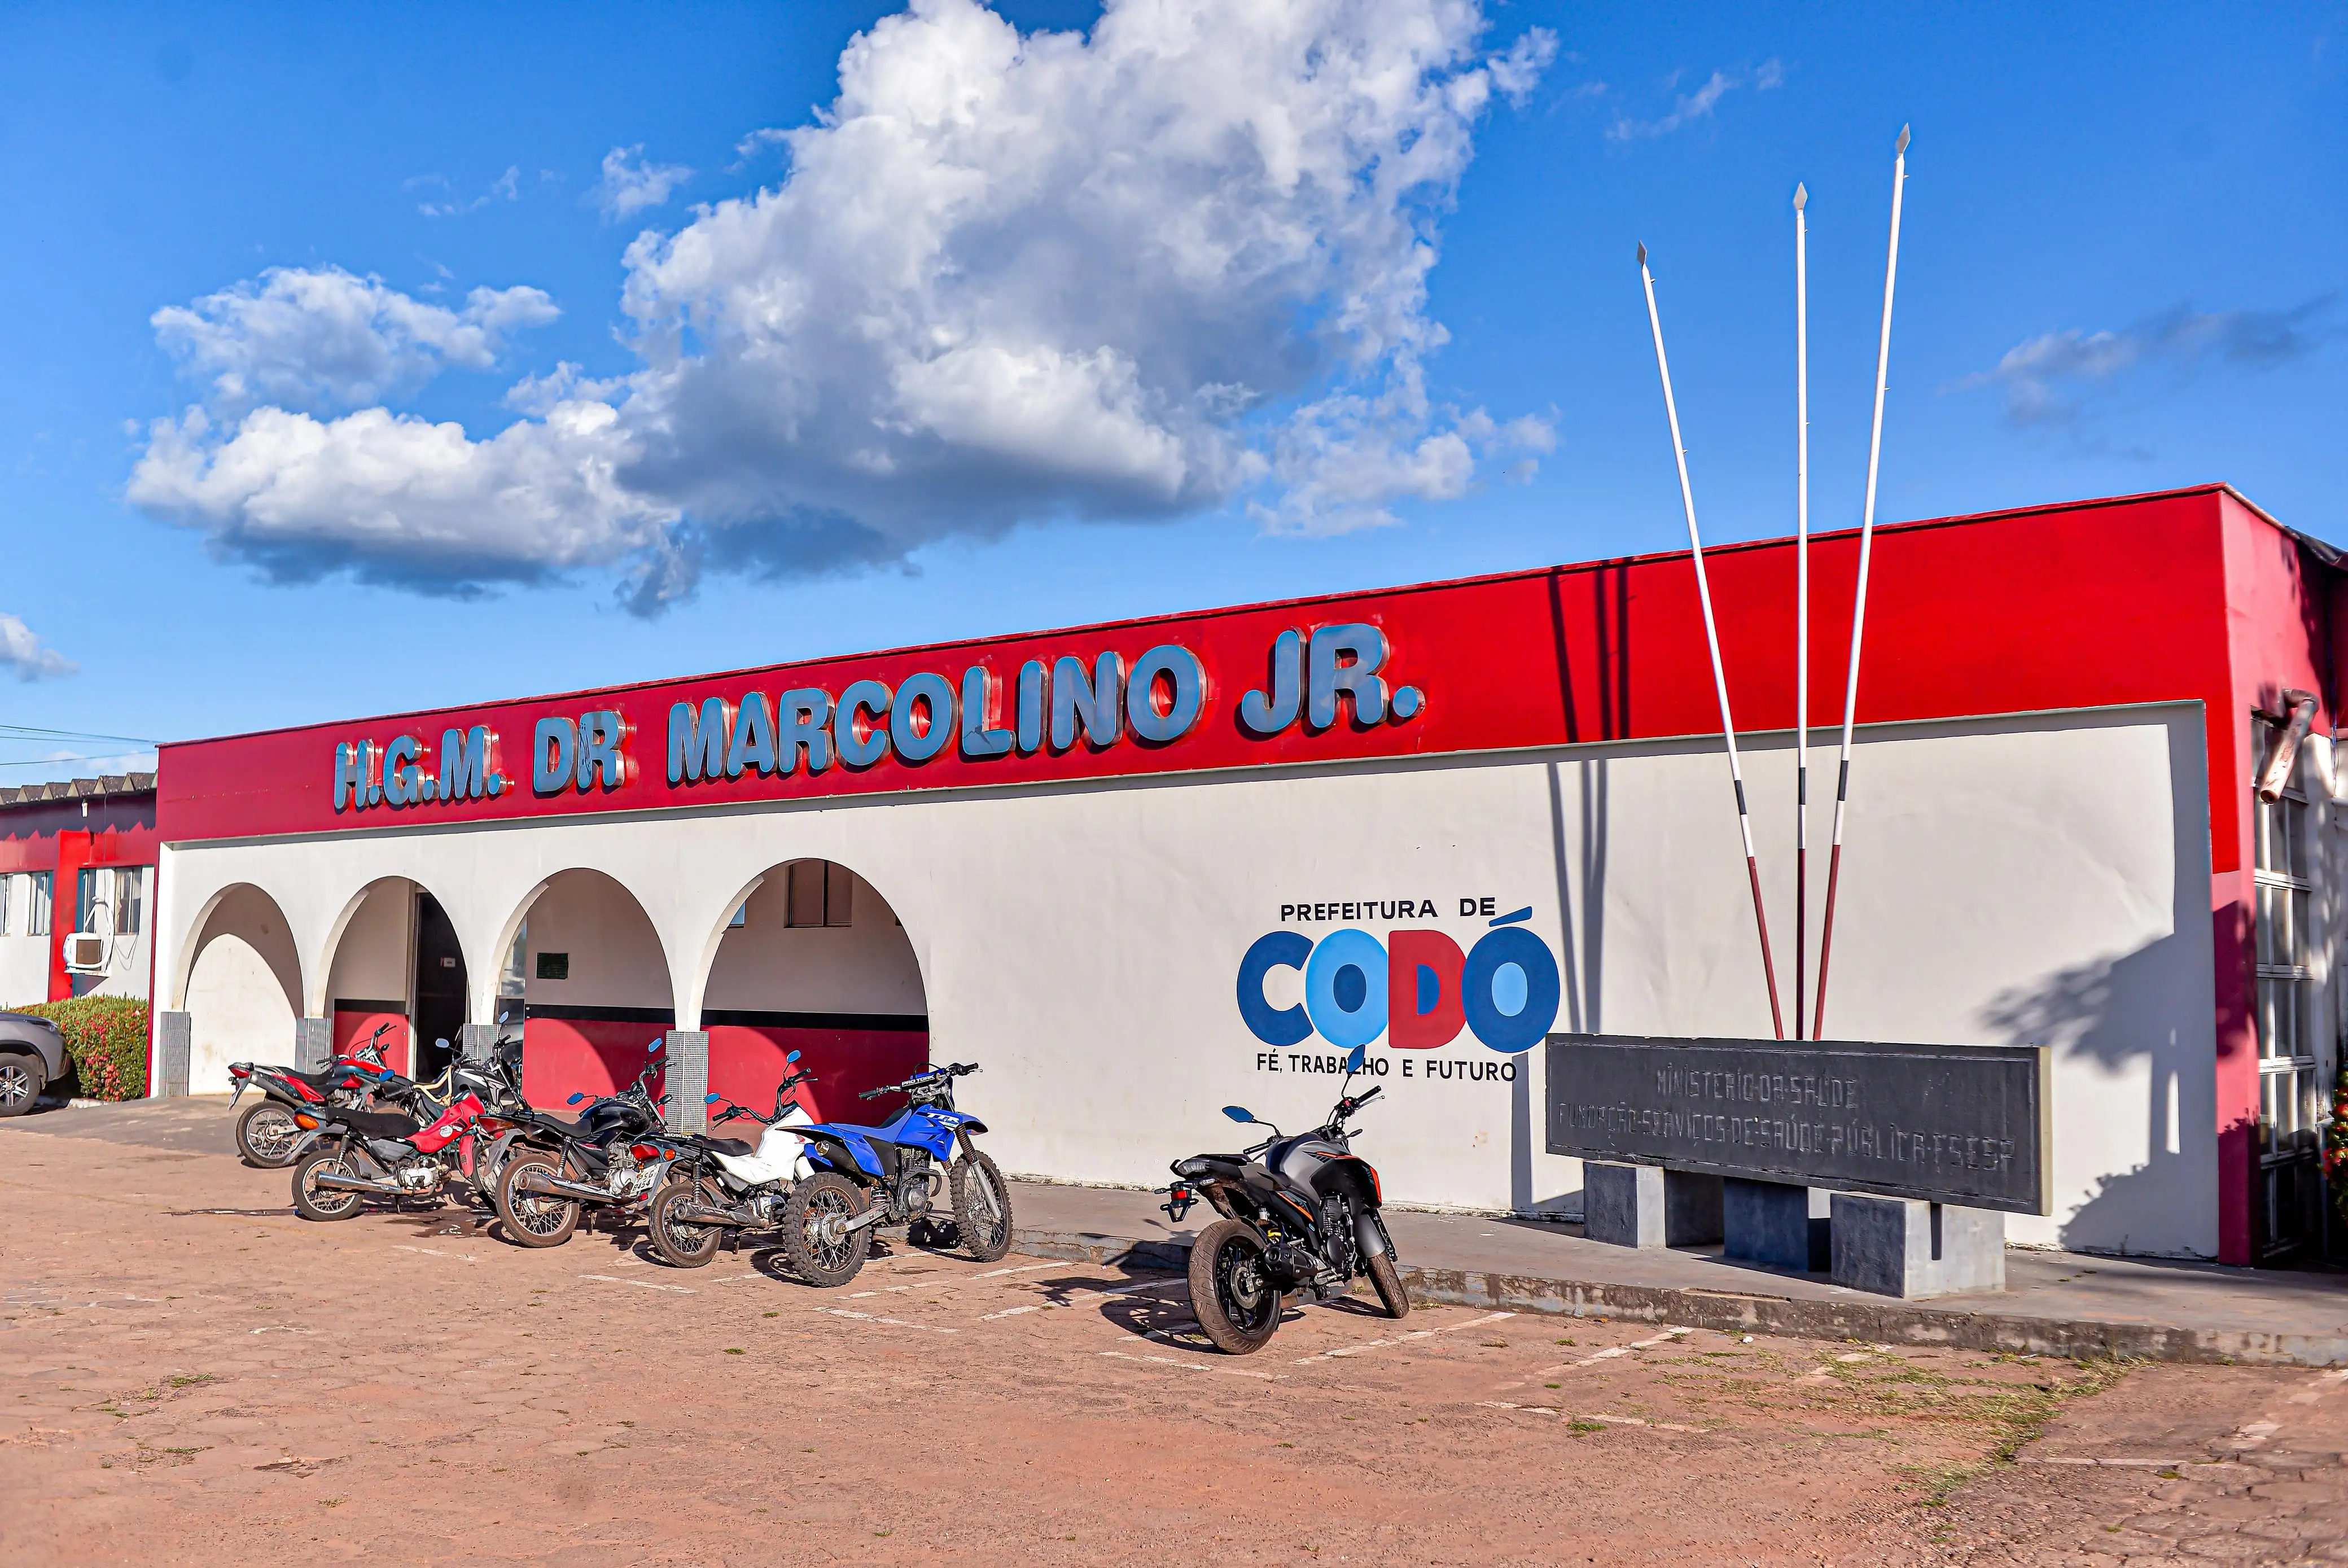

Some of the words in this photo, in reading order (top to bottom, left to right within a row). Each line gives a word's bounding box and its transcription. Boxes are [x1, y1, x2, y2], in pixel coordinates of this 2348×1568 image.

[335, 725, 511, 811] H.G.M.
[533, 709, 625, 794] DR
[668, 645, 1207, 785] MARCOLINO
[1241, 623, 1425, 734] JR.
[1281, 900, 1438, 922] PREFEITURA
[1460, 897, 1496, 917] DE
[1237, 906, 1561, 1053] CODÓ
[1257, 1049, 1282, 1074] FÉ,
[1403, 1059, 1413, 1077] E
[1426, 1060, 1517, 1081] FUTURO
